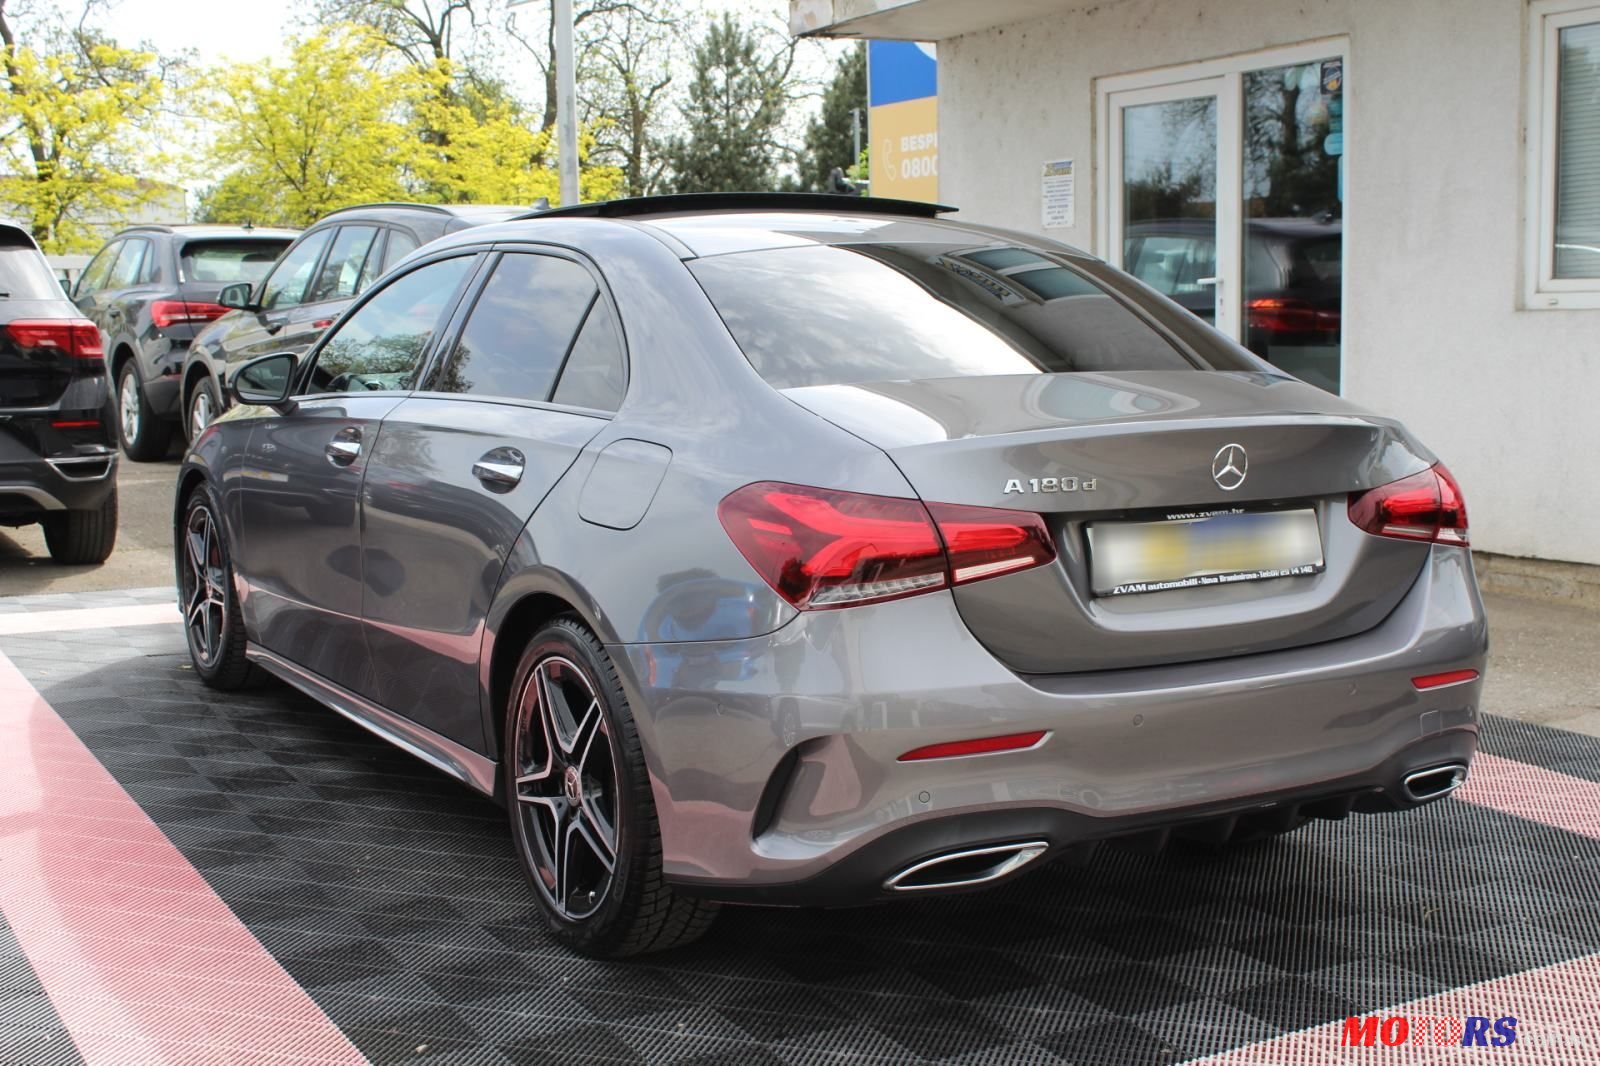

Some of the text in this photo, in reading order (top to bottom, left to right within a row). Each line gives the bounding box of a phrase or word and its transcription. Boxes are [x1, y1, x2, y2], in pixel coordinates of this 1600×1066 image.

[1166, 508, 1245, 520] www.zvam.hr
[1112, 583, 1146, 594] ZVAM
[1147, 578, 1198, 591] automobili
